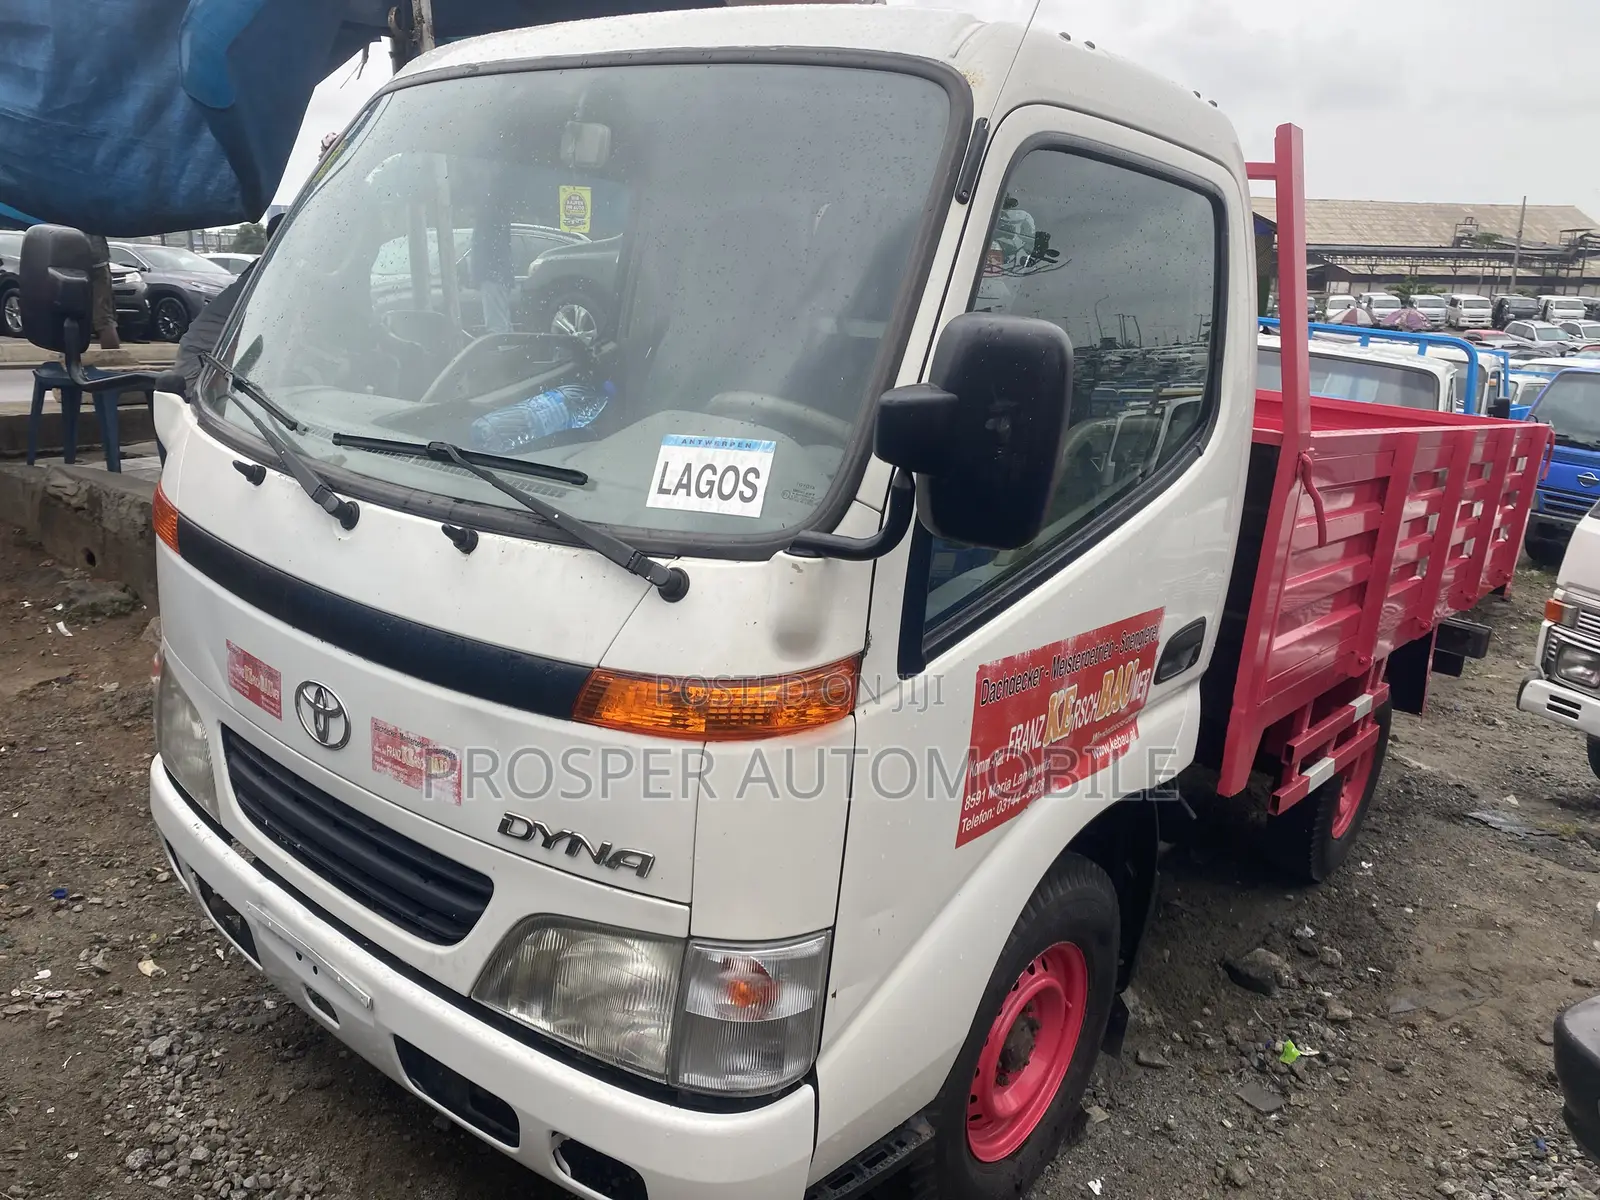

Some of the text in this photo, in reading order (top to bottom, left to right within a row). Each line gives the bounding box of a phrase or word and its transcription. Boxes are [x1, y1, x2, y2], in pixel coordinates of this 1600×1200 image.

[681, 437, 753, 449] ANTWERPEN
[656, 461, 761, 503] LAGOS
[980, 663, 1045, 707] Dachdecker
[1007, 713, 1046, 761] FRANZ
[964, 788, 986, 811] 8591
[988, 778, 1011, 800] Maria
[962, 806, 996, 833] Telefon:
[497, 810, 656, 879] DYNA
